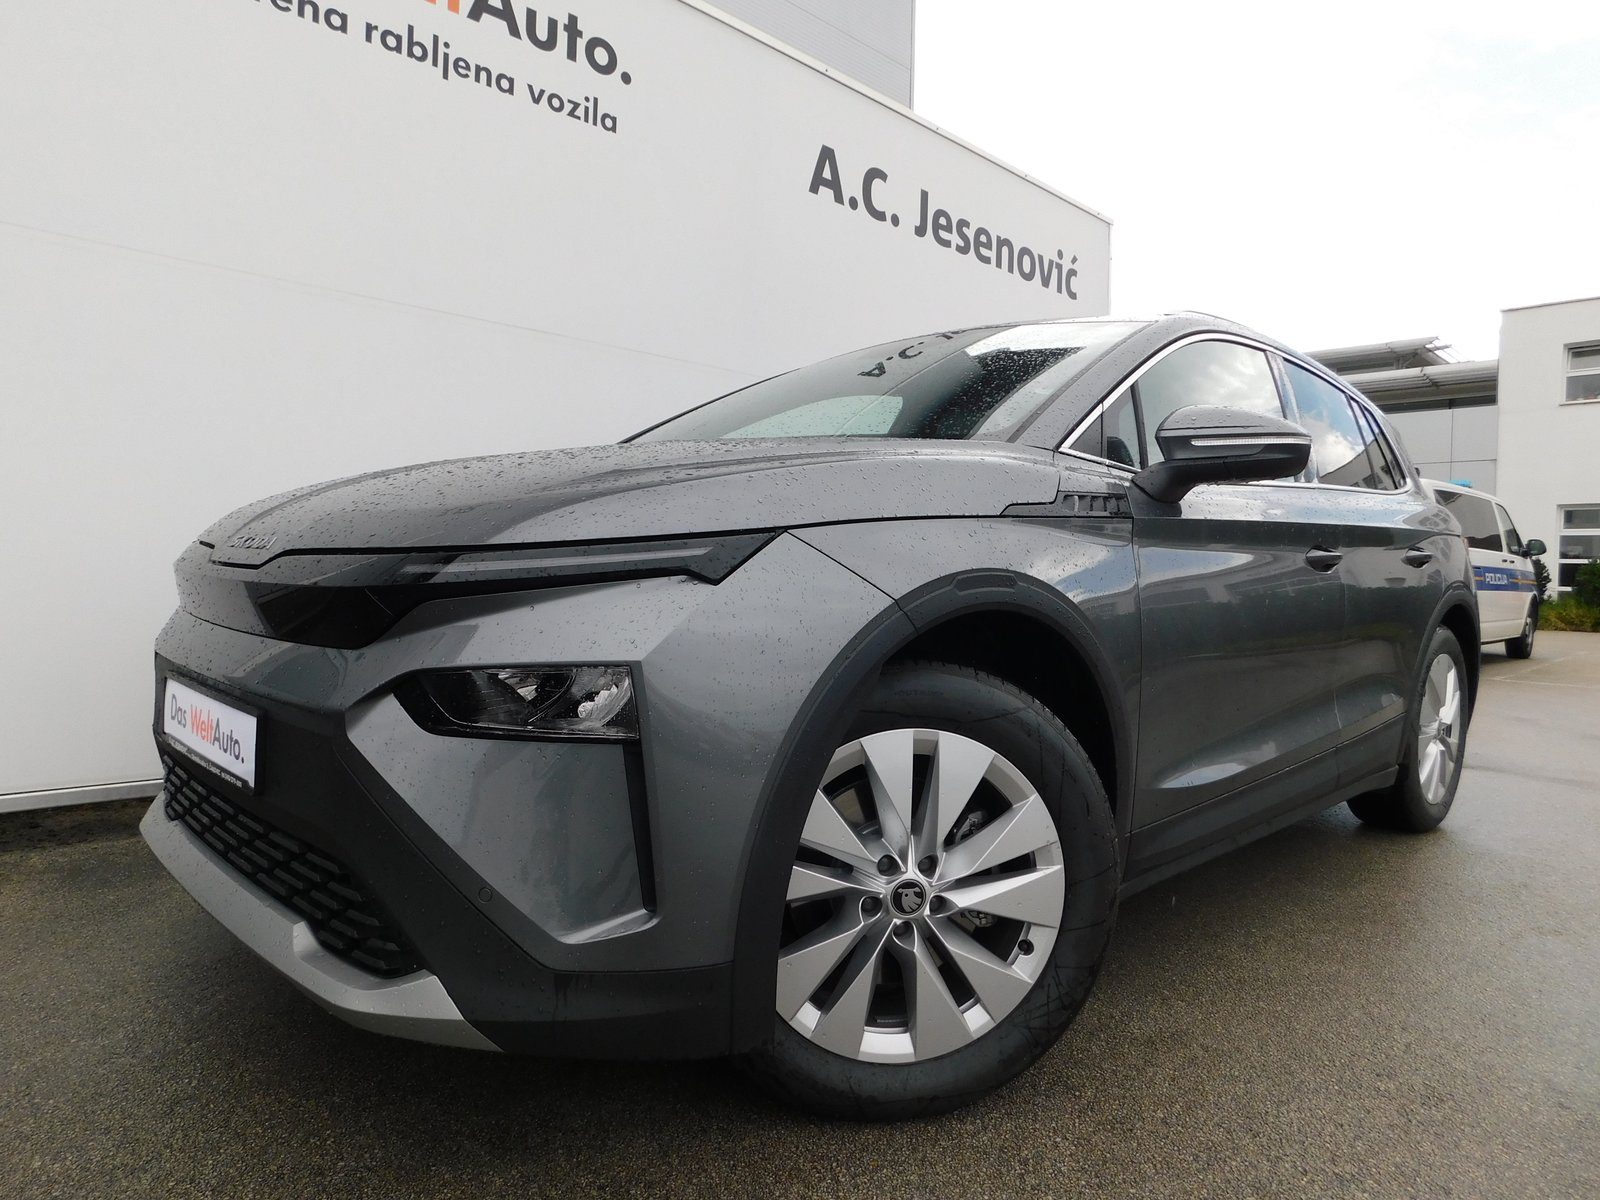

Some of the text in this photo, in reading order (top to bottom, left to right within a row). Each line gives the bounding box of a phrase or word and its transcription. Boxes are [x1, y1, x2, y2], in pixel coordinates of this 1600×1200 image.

[254, 0, 617, 134] ena rabljena vozila
[424, 0, 632, 86] Auto.
[808, 144, 1078, 301] A.C. Jesenović
[170, 693, 187, 729] Das
[190, 703, 245, 764] WeltAuto.
